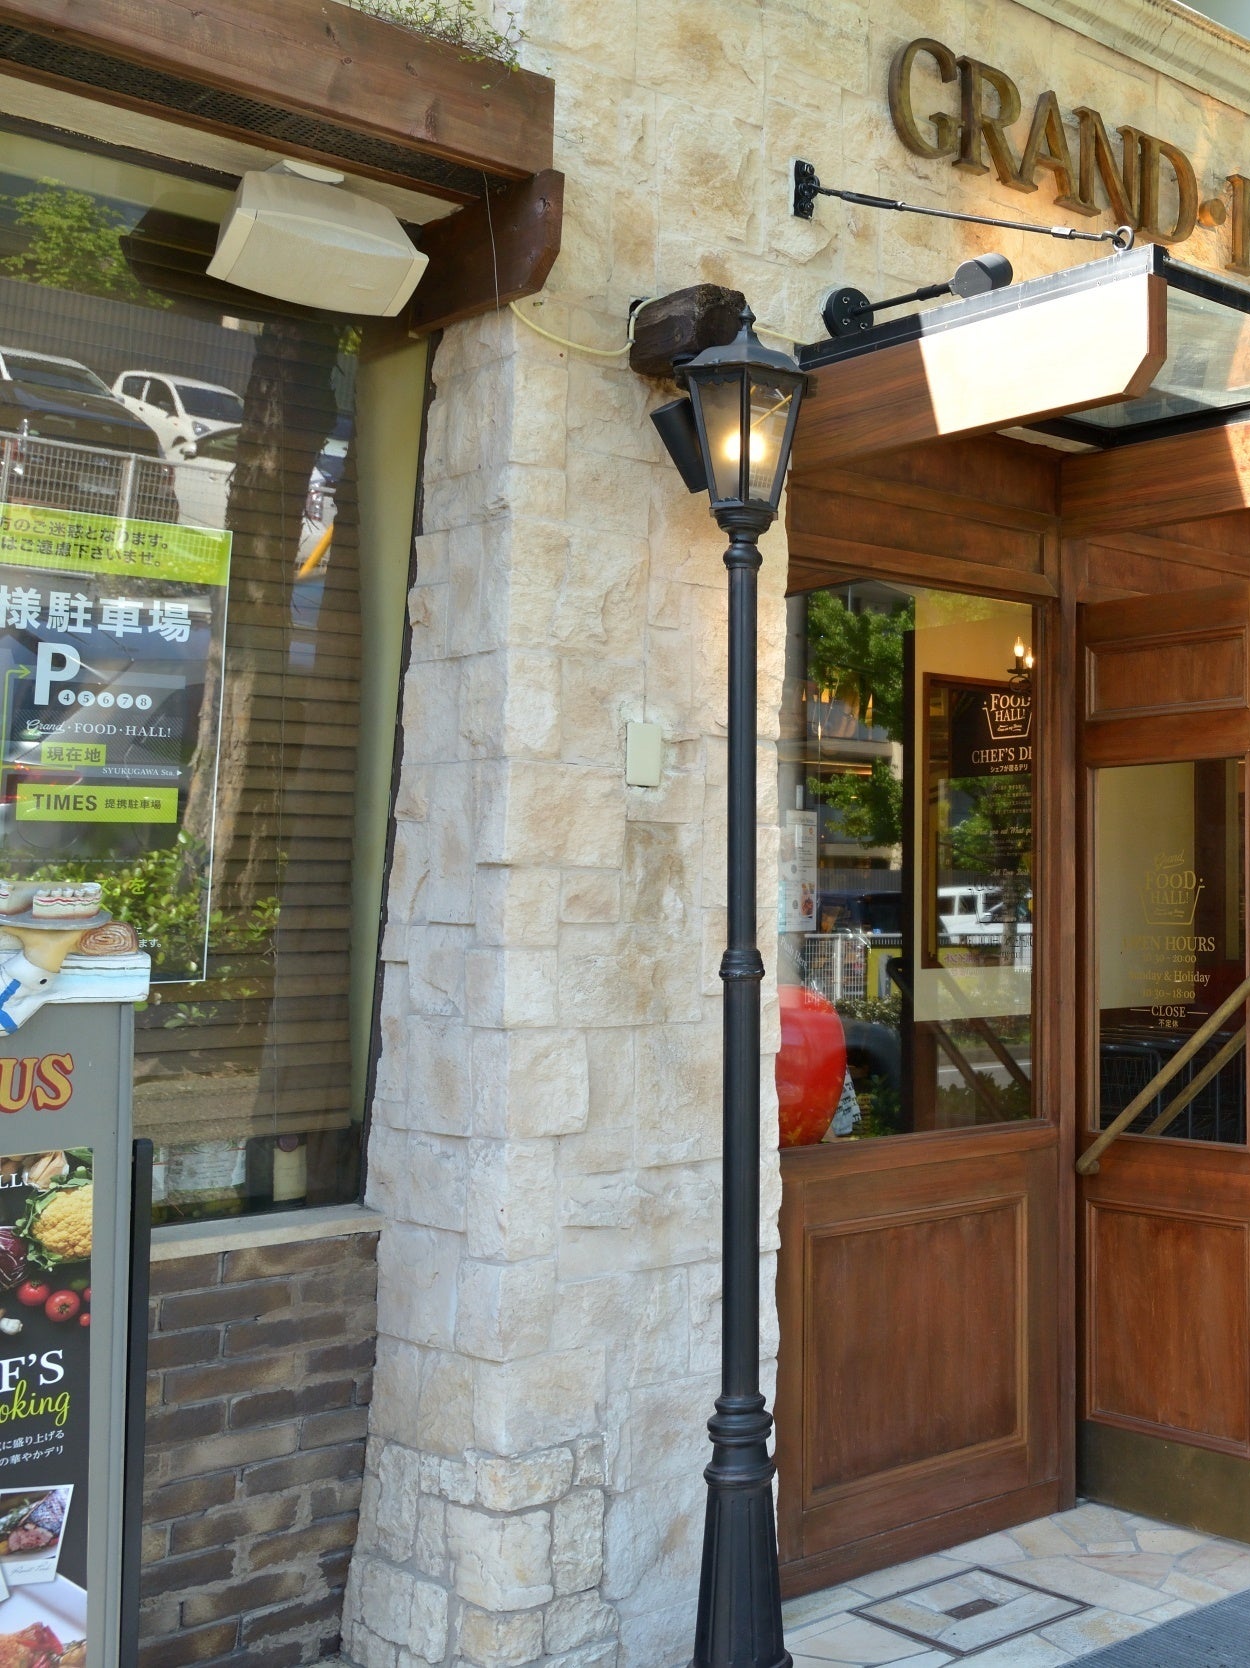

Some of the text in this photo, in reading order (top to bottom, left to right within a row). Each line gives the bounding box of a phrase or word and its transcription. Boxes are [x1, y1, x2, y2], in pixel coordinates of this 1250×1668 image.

[0, 585, 191, 643] 様駐車場
[34, 642, 81, 705] P
[990, 694, 1031, 711] FOOD
[26, 719, 171, 738] Grand FOOD HALL!
[47, 746, 101, 763] 現在地
[971, 747, 1015, 763] CHEF'S
[102, 766, 159, 776] SYUKUGAWA
[33, 793, 98, 811] TIMES
[104, 798, 162, 810] 提携駐車場
[1145, 870, 1197, 890] FOOD
[1165, 936, 1216, 952] HOURS
[1174, 970, 1211, 987] Holiday
[1151, 1005, 1186, 1018] CLOSE
[1158, 1018, 1179, 1028] 不定休
